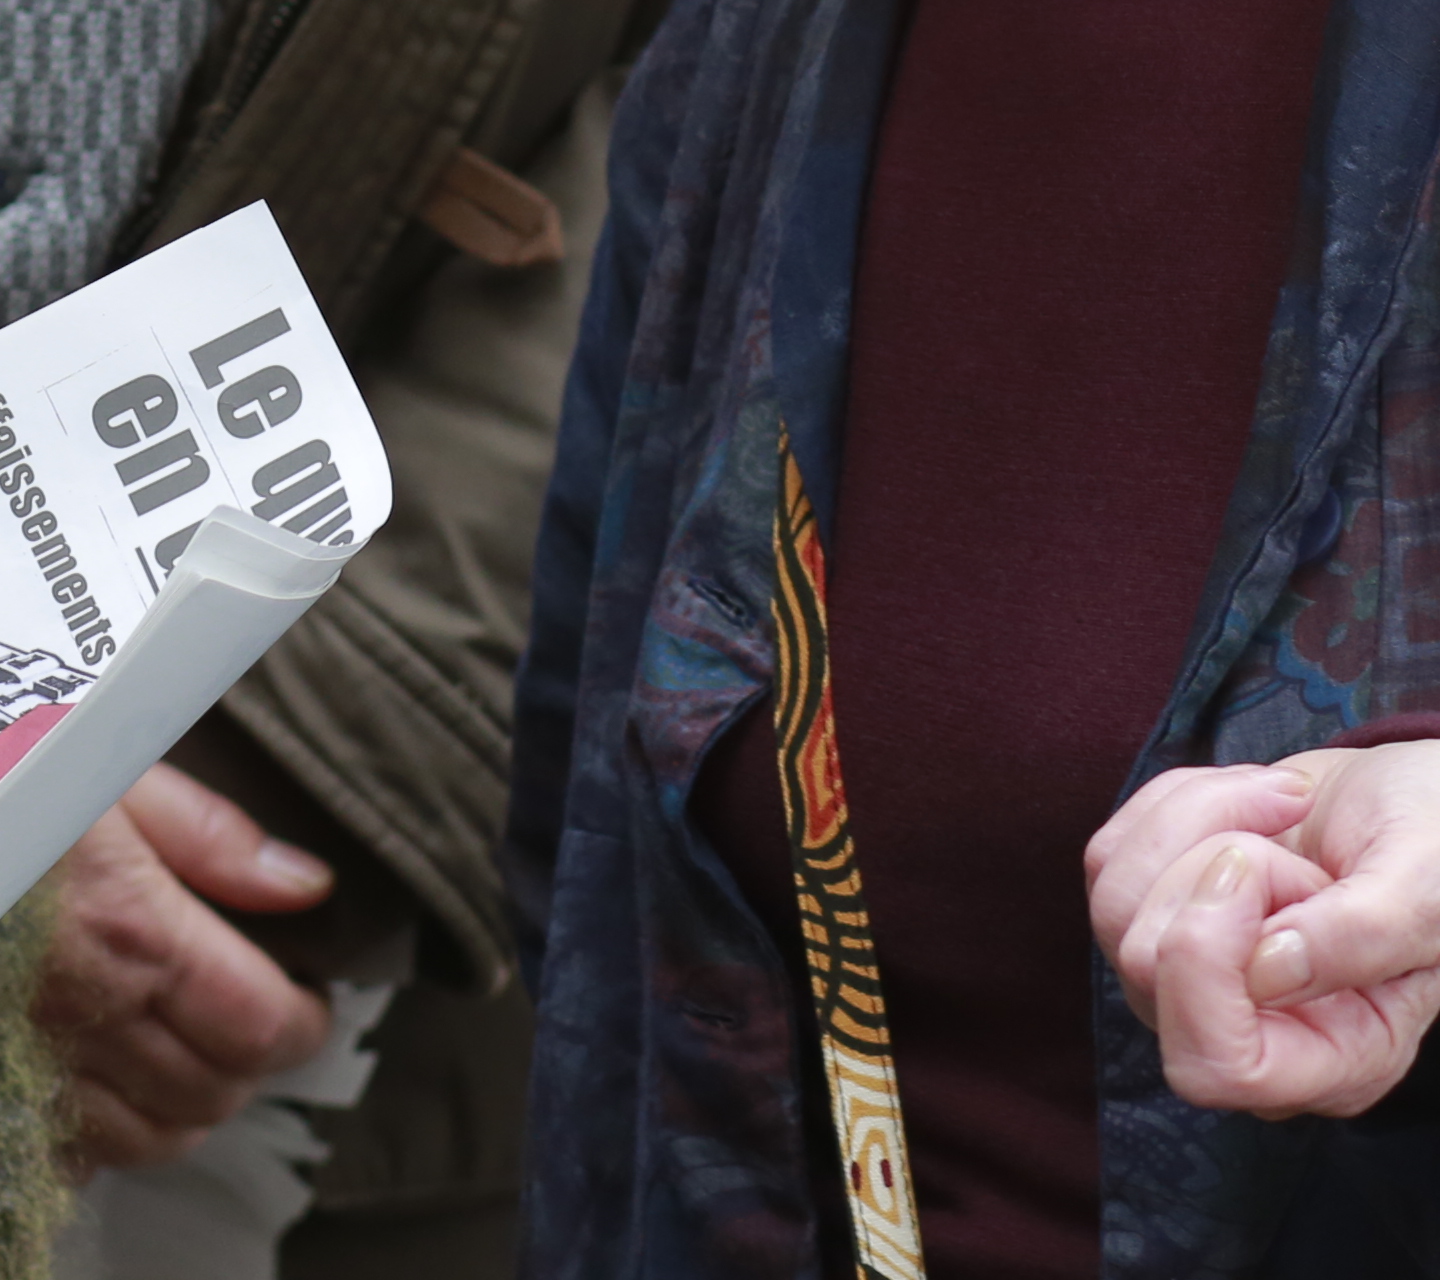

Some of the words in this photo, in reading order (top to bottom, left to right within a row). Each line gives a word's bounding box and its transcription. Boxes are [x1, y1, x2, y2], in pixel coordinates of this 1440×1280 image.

[92, 373, 211, 517] en
[189, 307, 302, 440] Le
[251, 438, 354, 545] qu
